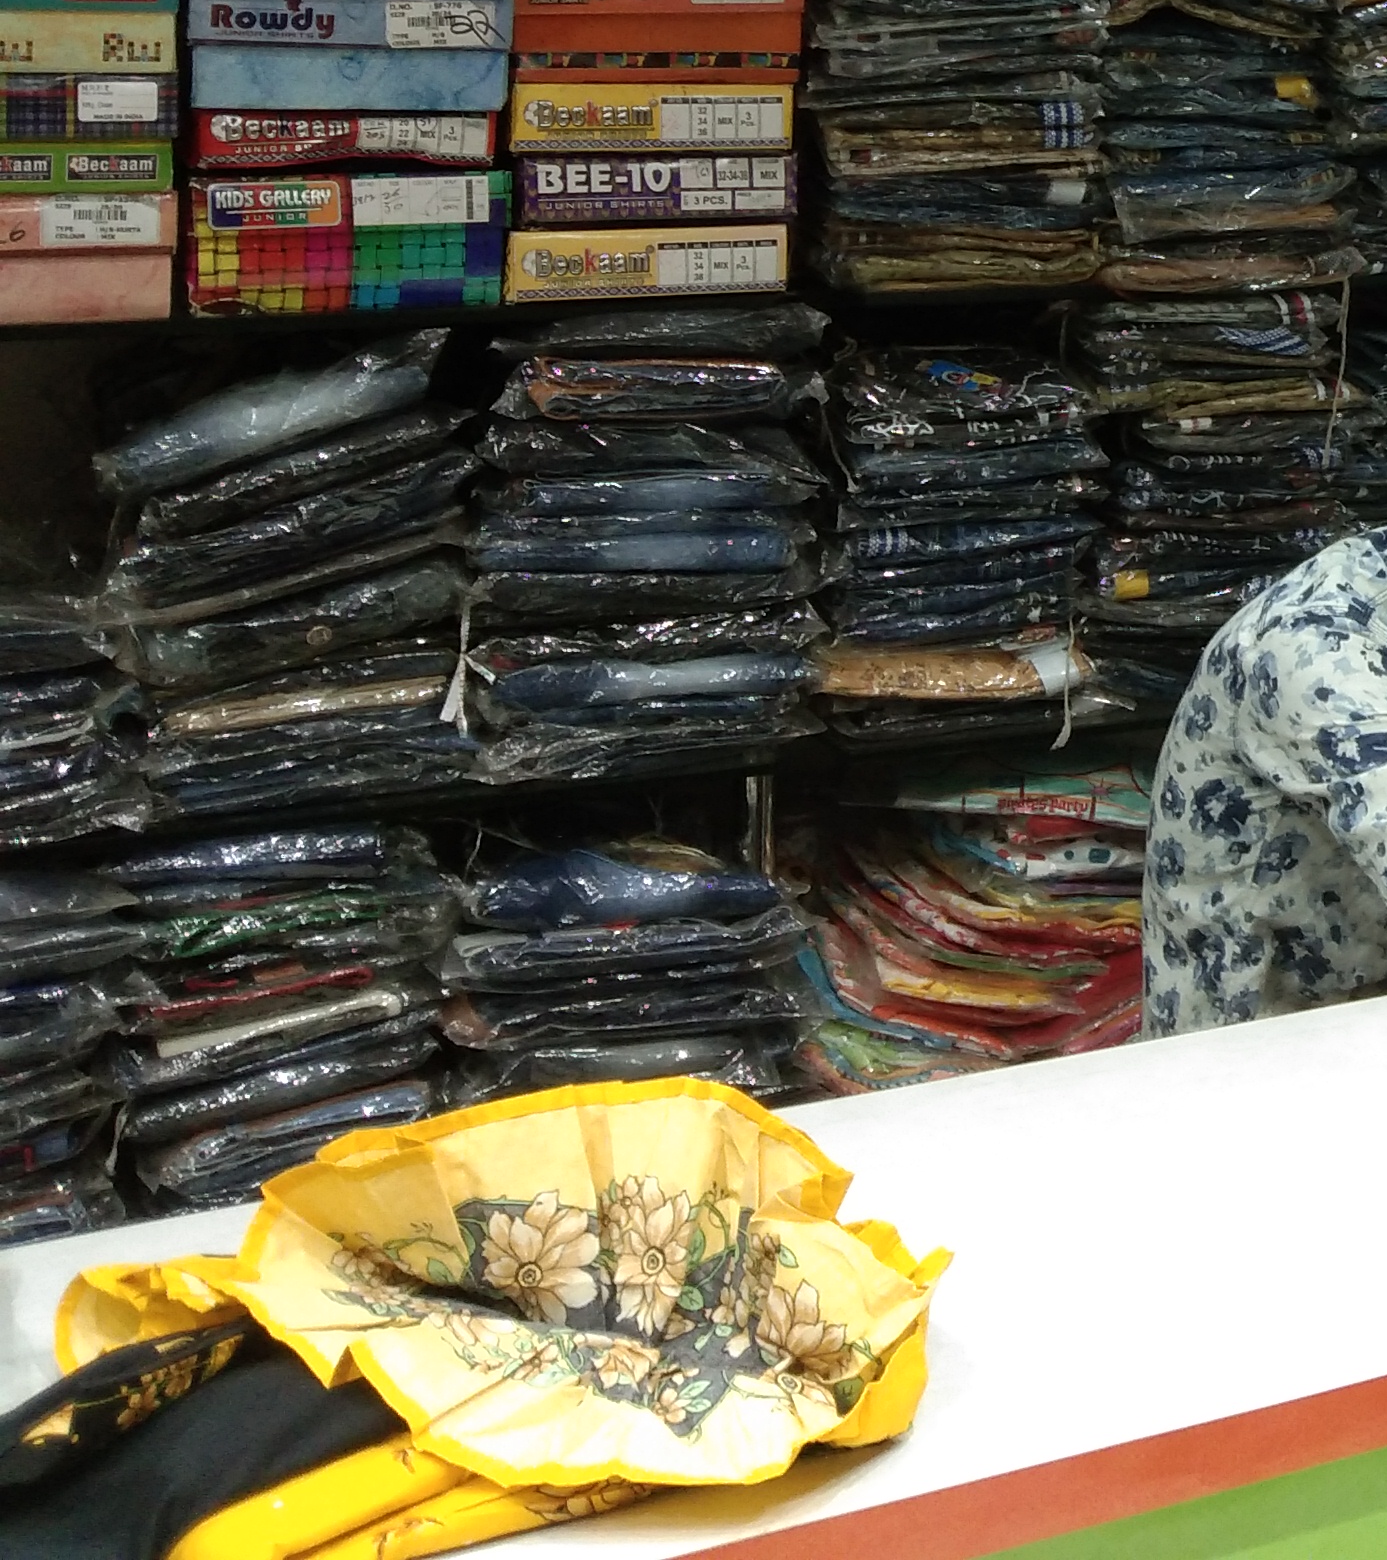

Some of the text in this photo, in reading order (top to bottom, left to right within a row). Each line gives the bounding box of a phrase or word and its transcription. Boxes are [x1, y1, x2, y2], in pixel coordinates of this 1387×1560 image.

[718, 116, 733, 125] MIX
[225, 115, 351, 142] Beckaam
[235, 144, 290, 154] JUNIOR
[536, 163, 672, 194] BEE-10
[760, 169, 778, 180] MIX
[546, 200, 665, 210] JUNIOR SHIRTS
[243, 212, 306, 222] JUNIOR
[543, 280, 592, 288] JUNIOR
